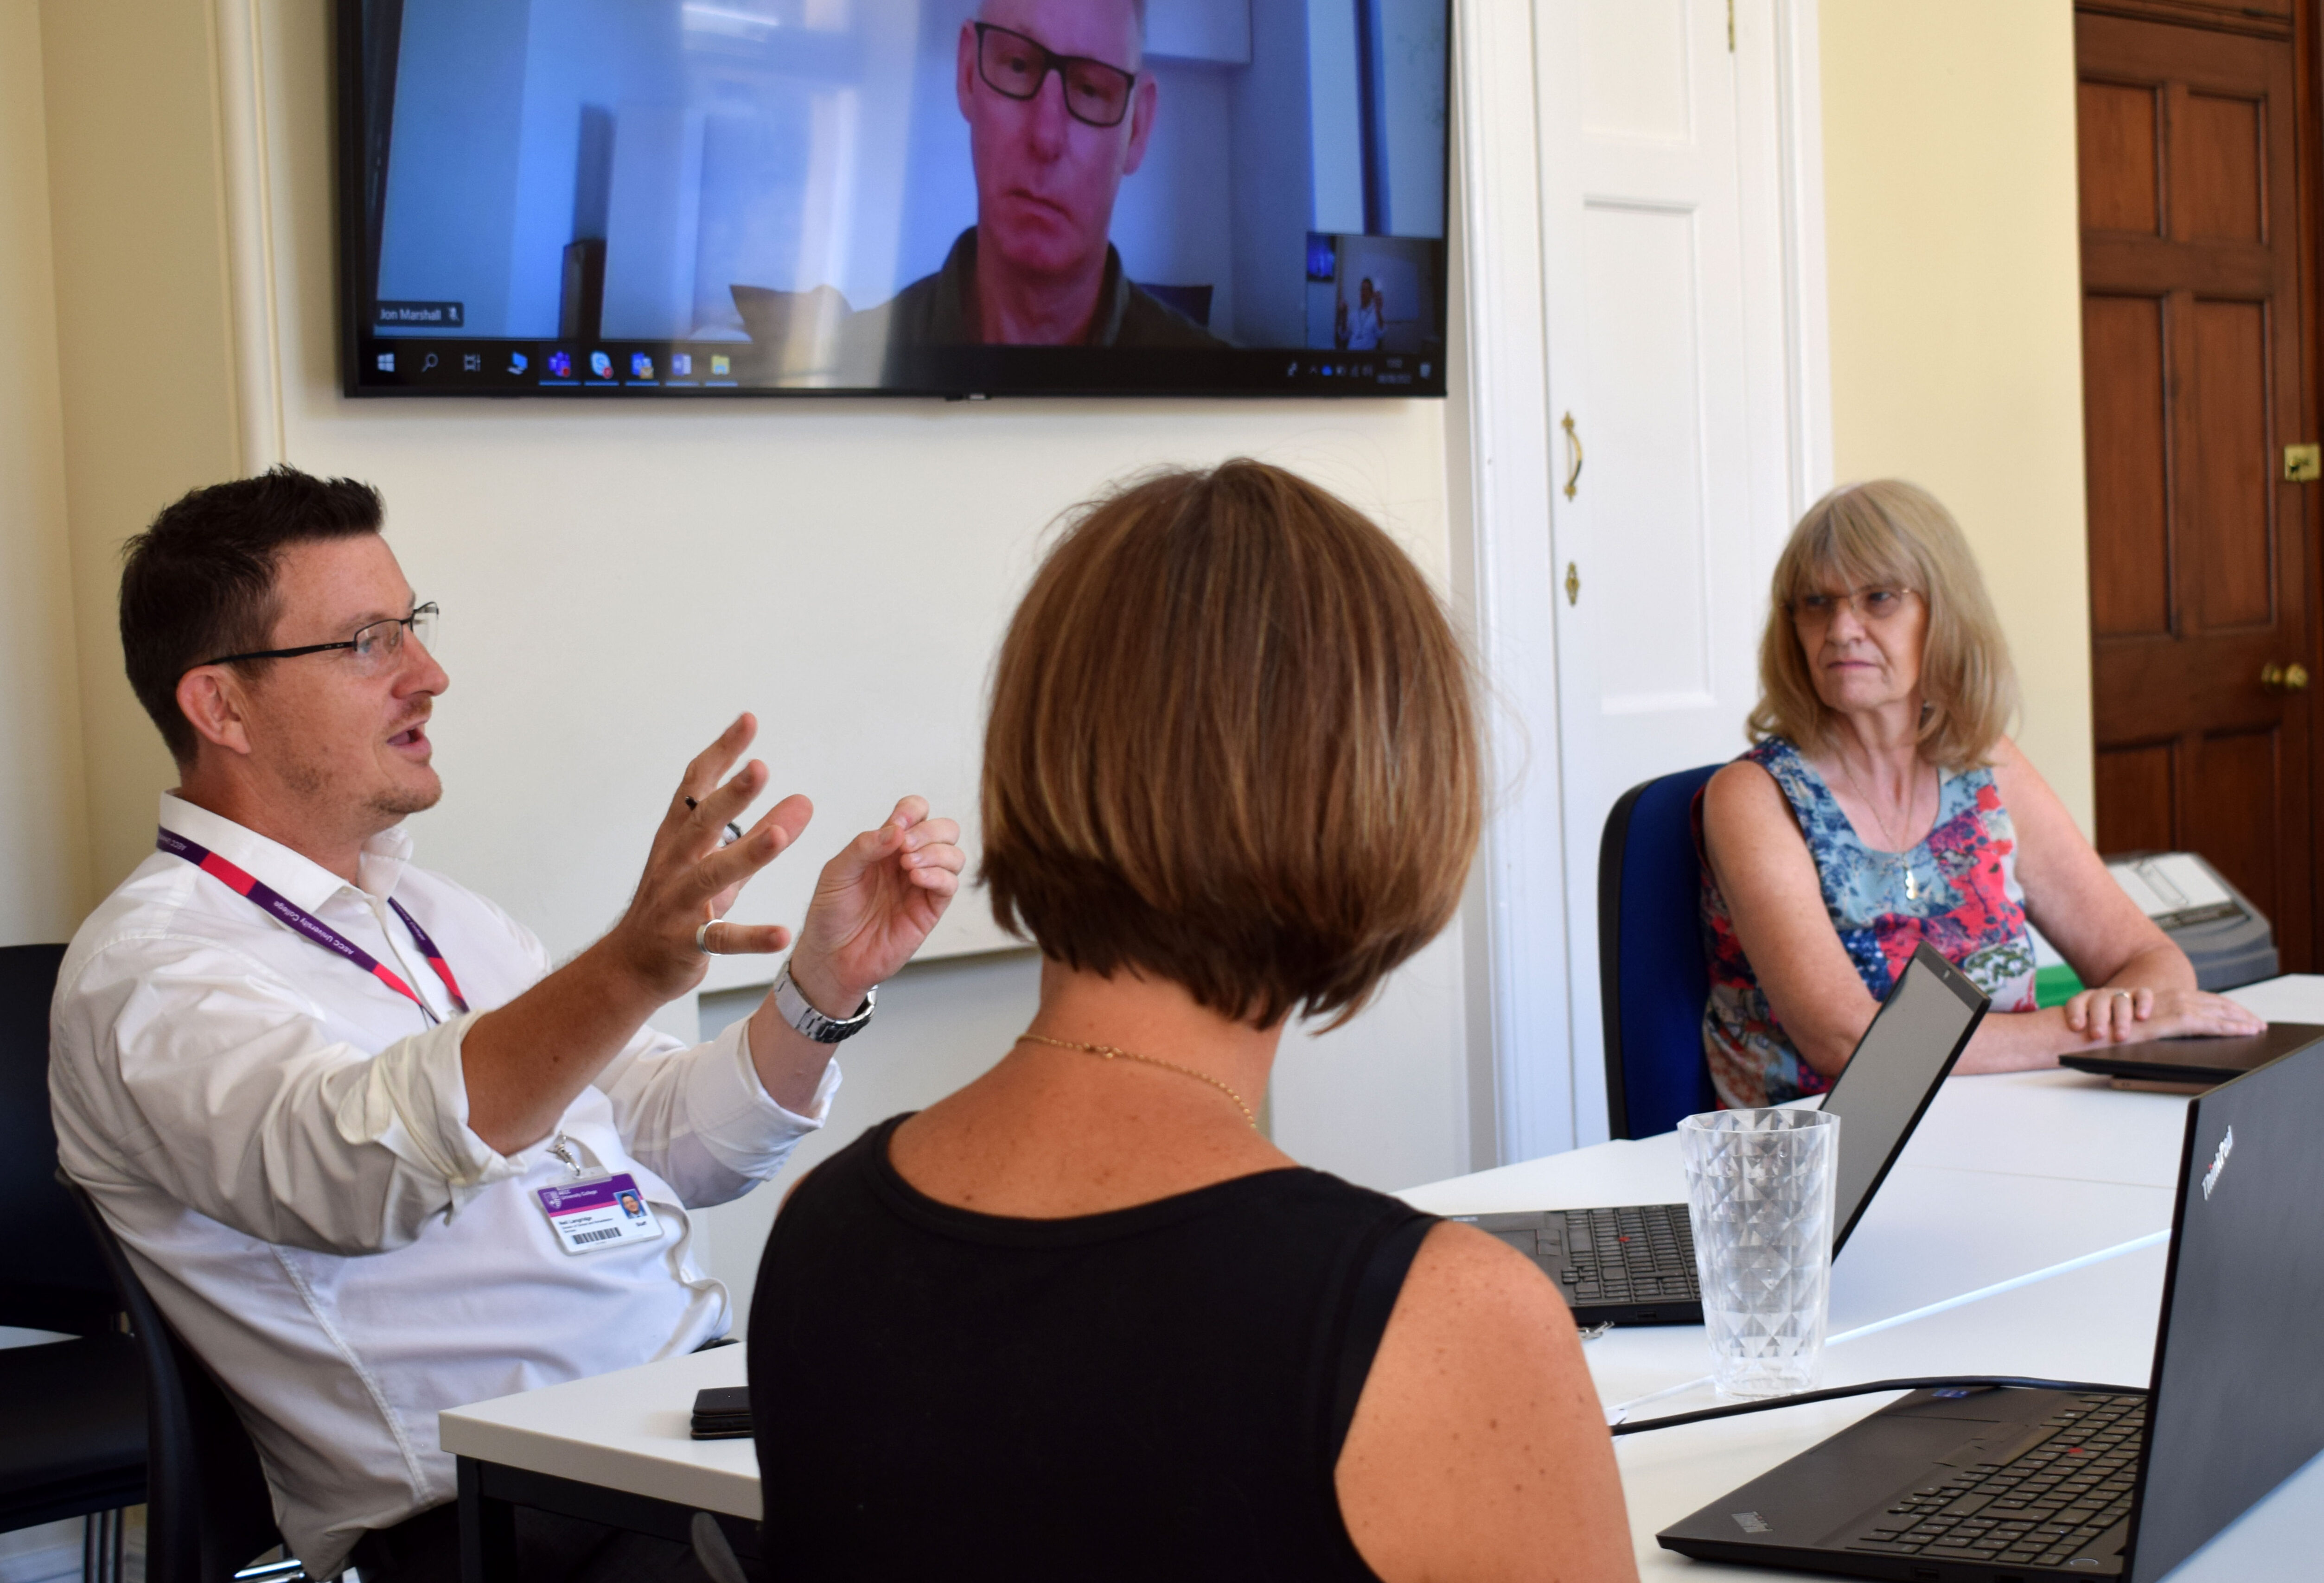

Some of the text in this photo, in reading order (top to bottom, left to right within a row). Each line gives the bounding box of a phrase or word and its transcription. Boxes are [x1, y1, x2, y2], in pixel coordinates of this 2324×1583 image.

[380, 308, 441, 321] Jon Marshall
[274, 901, 354, 954] AECC University College
